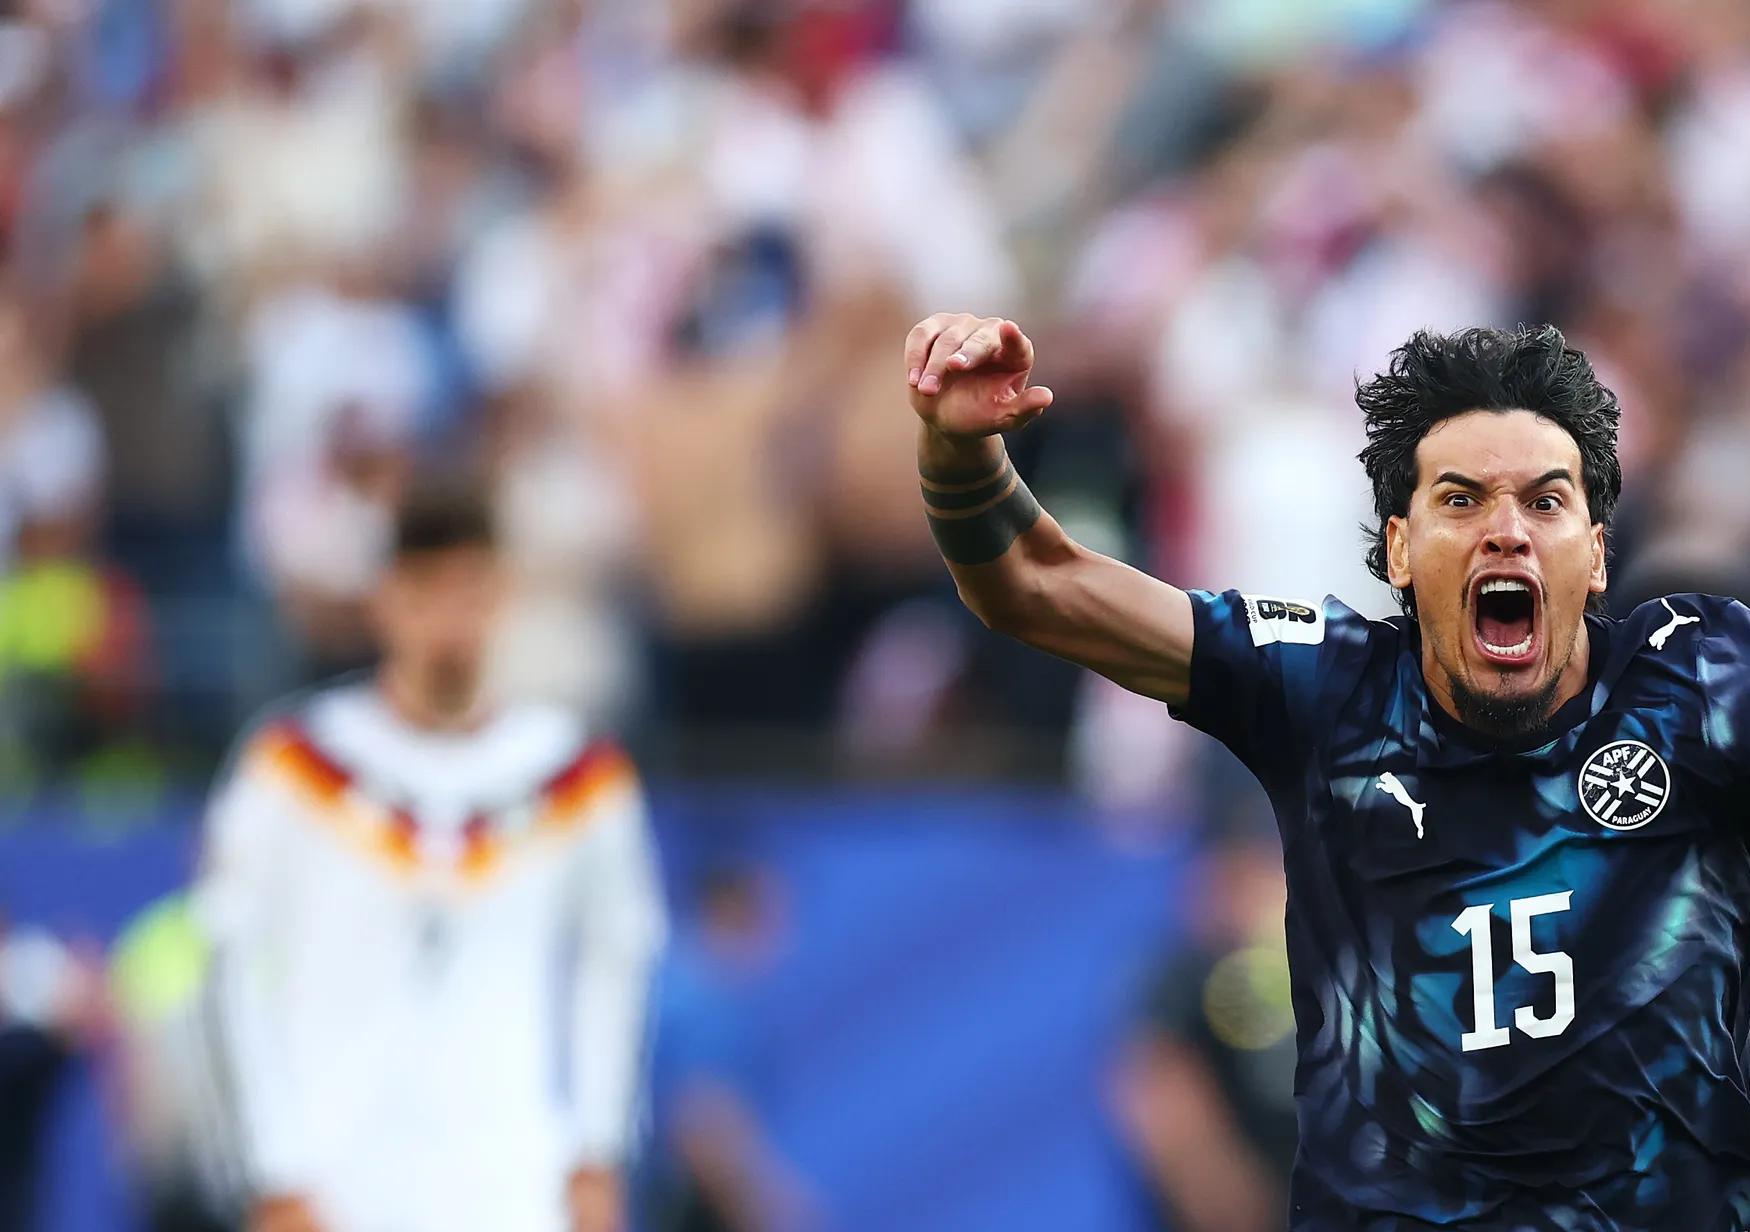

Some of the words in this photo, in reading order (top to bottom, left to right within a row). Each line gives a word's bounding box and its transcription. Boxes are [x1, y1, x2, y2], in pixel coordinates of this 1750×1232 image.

[1603, 746, 1631, 766] APF
[1612, 806, 1652, 824] PARAGUAY
[1451, 890, 1575, 1051] 15
